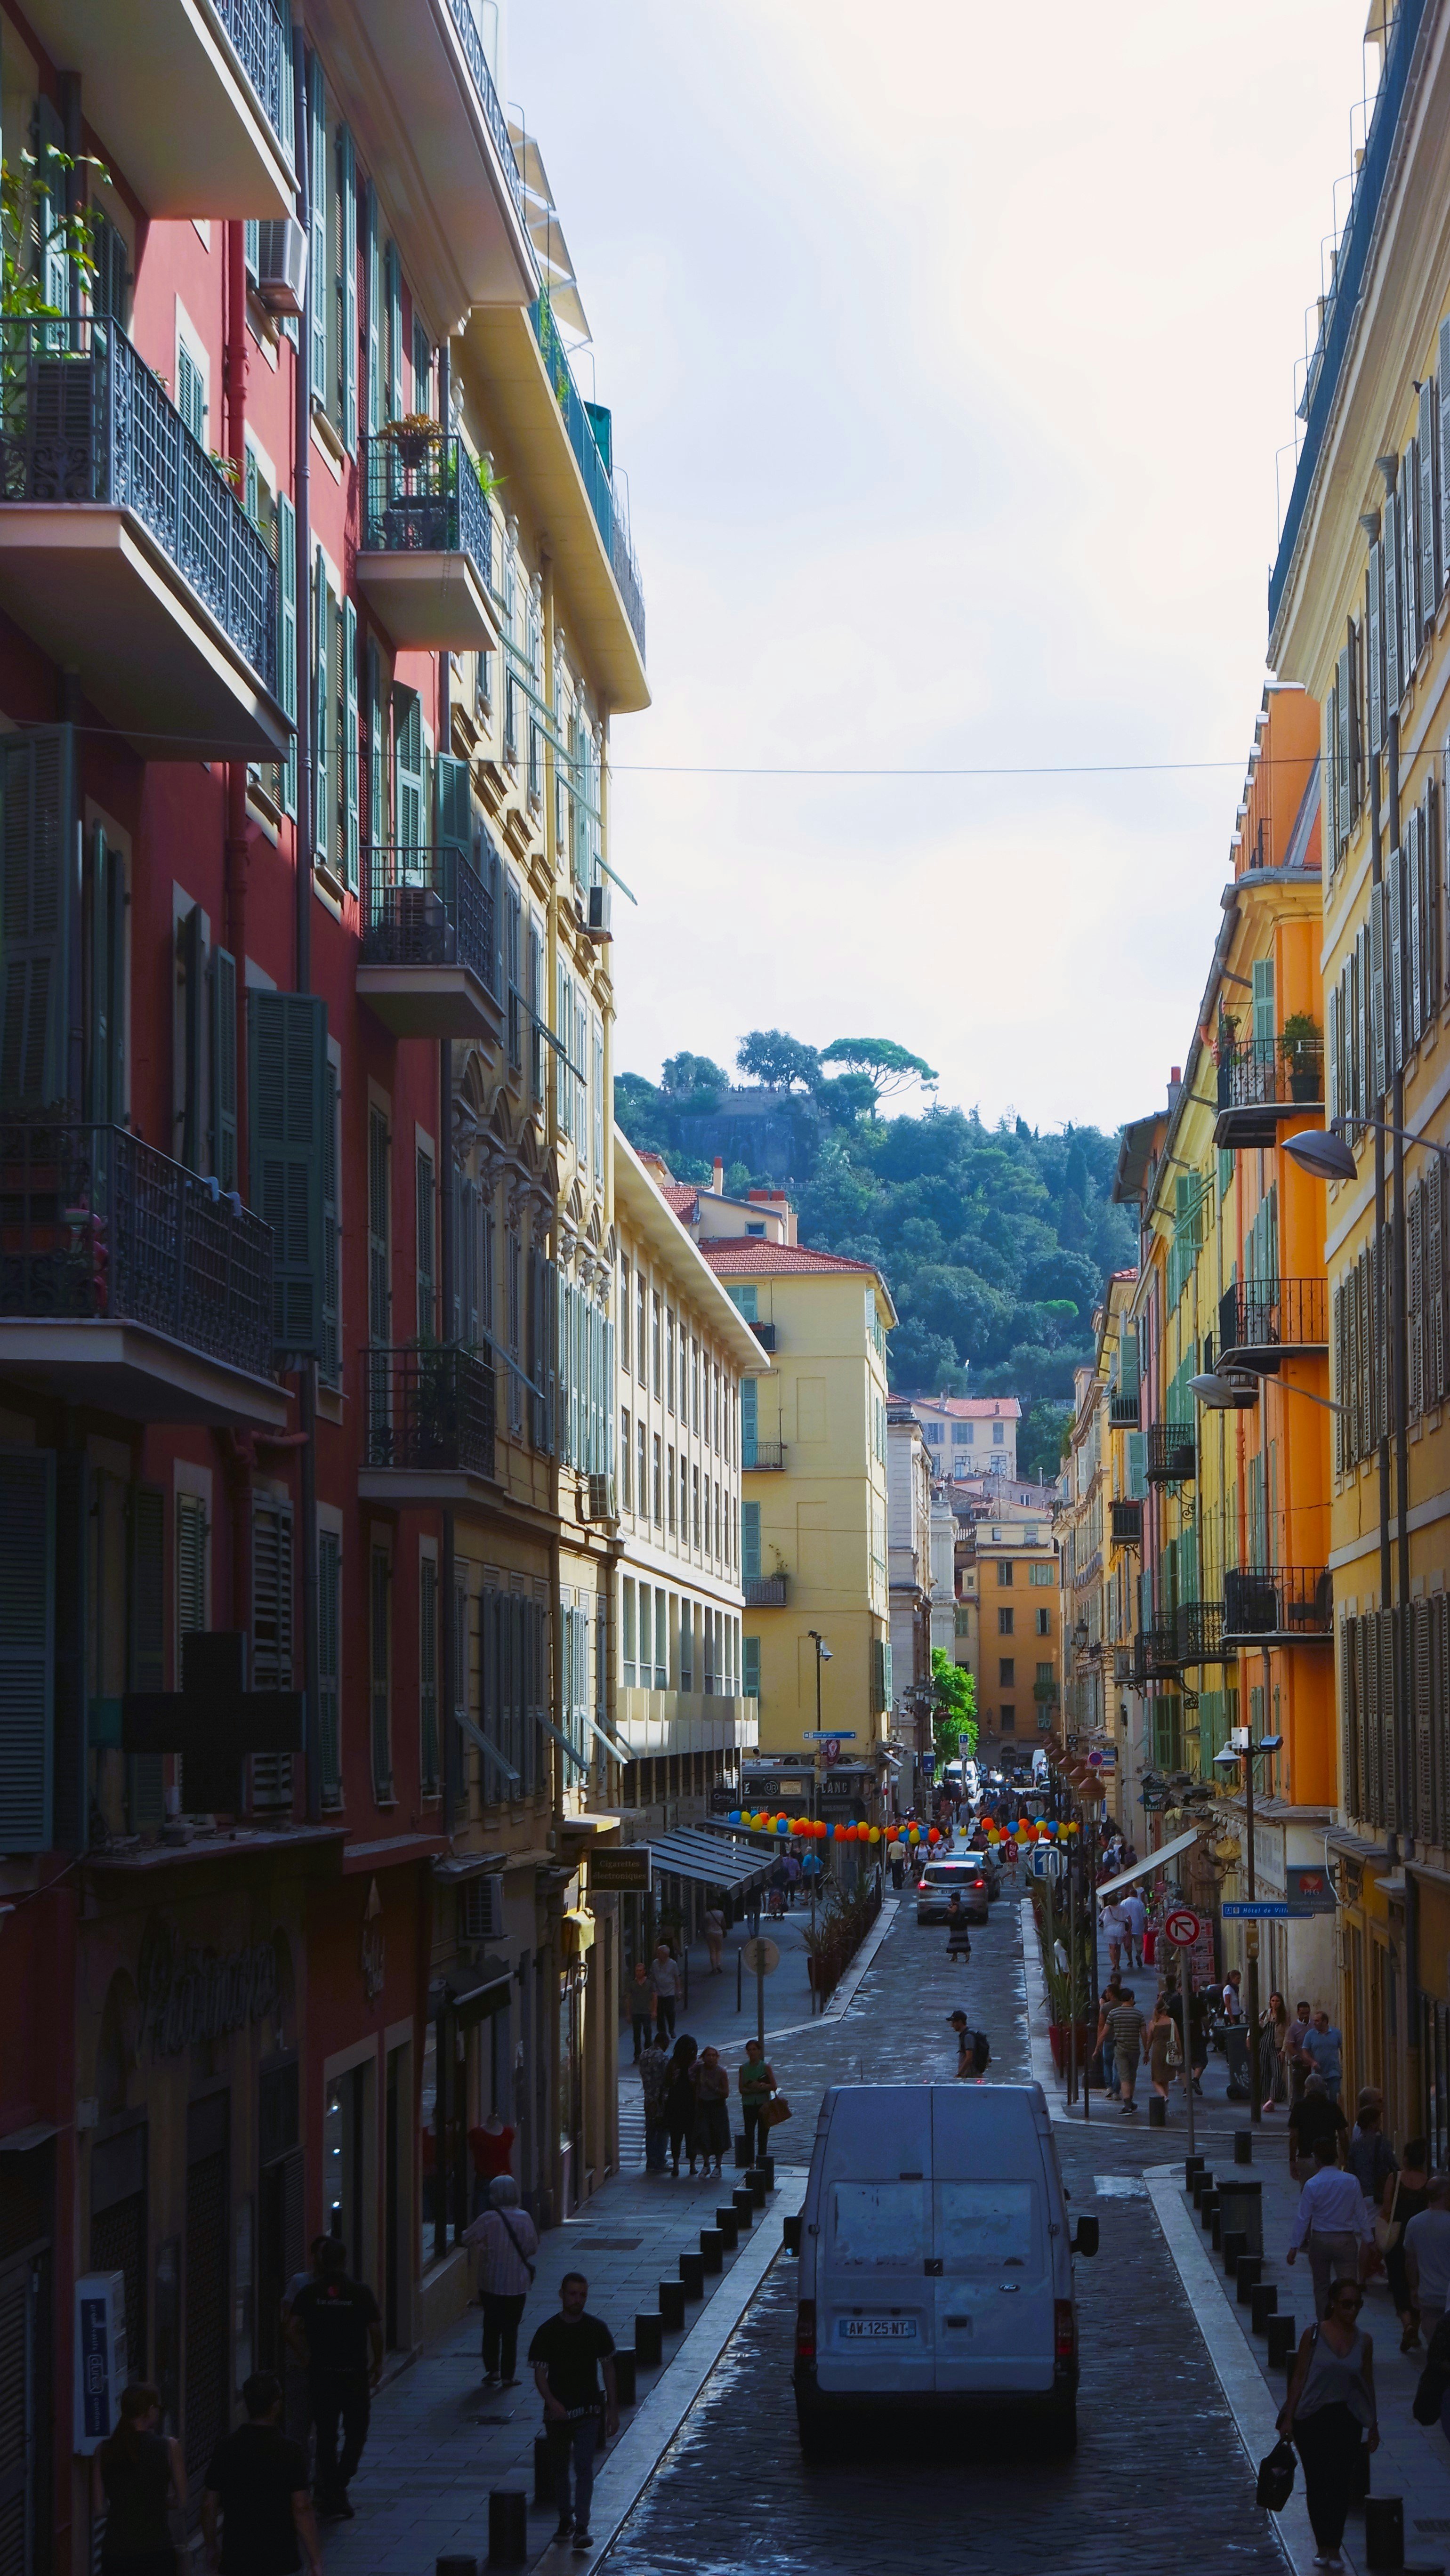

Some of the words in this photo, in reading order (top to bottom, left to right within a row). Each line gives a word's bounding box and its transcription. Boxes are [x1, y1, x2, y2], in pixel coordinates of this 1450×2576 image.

[599, 1860, 640, 1868] Cigarettes
[593, 1871, 647, 1881] électroniques
[1304, 1888, 1320, 1896] PFG
